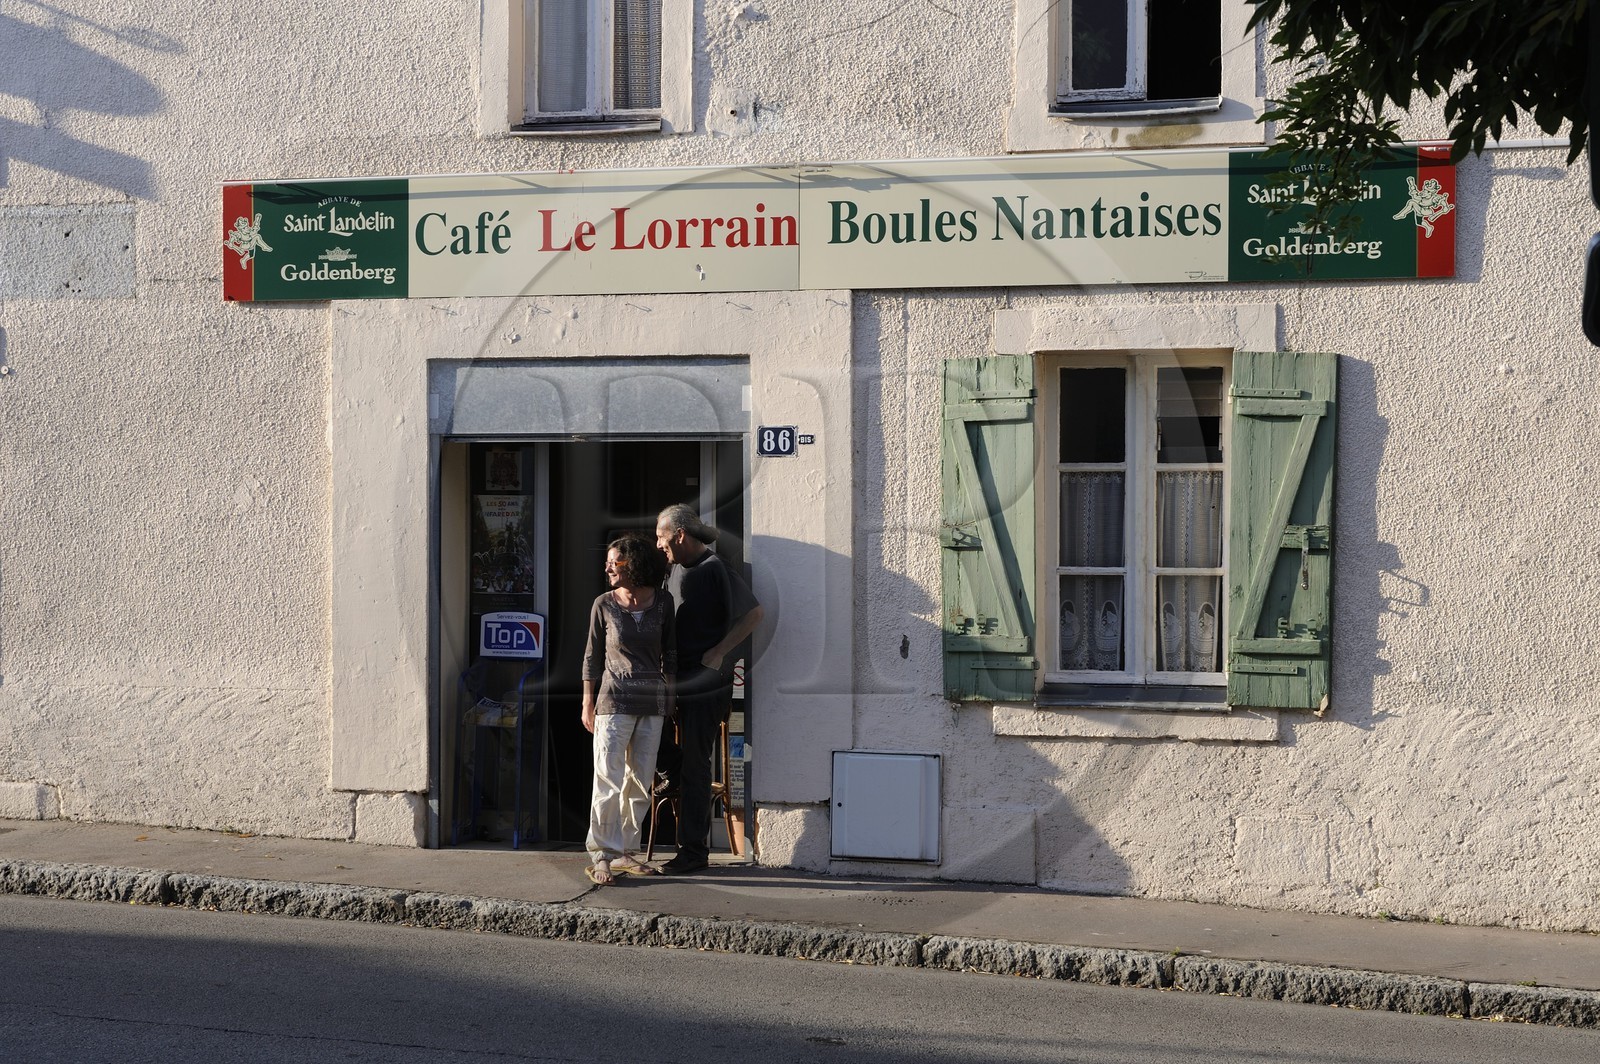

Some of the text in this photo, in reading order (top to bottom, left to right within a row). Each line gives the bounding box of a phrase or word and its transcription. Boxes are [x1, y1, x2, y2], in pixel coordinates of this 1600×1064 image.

[318, 196, 362, 208] ABBAYE DE
[283, 206, 395, 237] Saint Landelin
[415, 203, 799, 256] Café Le Lorrain
[828, 192, 1221, 245] Boules Nantaises
[1242, 235, 1383, 260] Goldenberg
[280, 261, 397, 285] Goldenberg
[762, 429, 791, 452] 86
[487, 622, 526, 648] Top
